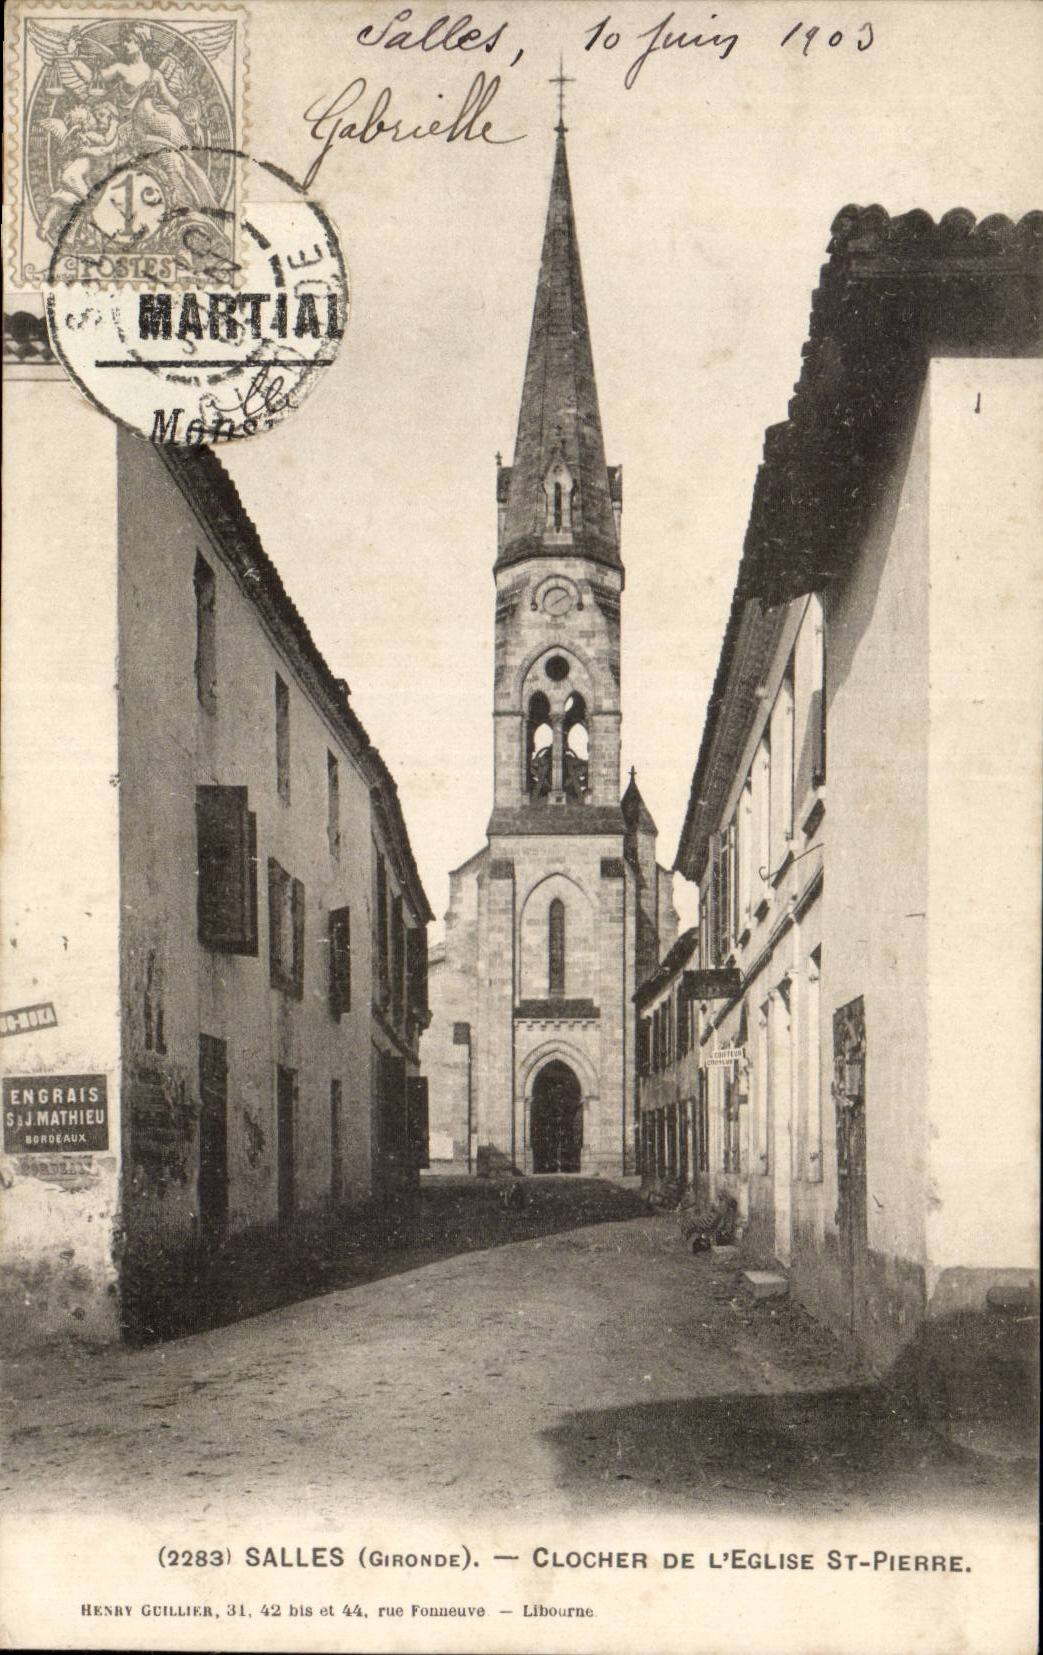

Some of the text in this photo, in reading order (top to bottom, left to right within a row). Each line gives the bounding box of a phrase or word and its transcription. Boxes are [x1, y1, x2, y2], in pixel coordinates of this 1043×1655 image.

[583, 16, 619, 52] 10
[302, 71, 527, 190] Gabrielle
[80, 255, 174, 279] POSTES
[10, 1086, 99, 1105] ENGRAIS
[25, 1133, 87, 1145] BORDEAUX
